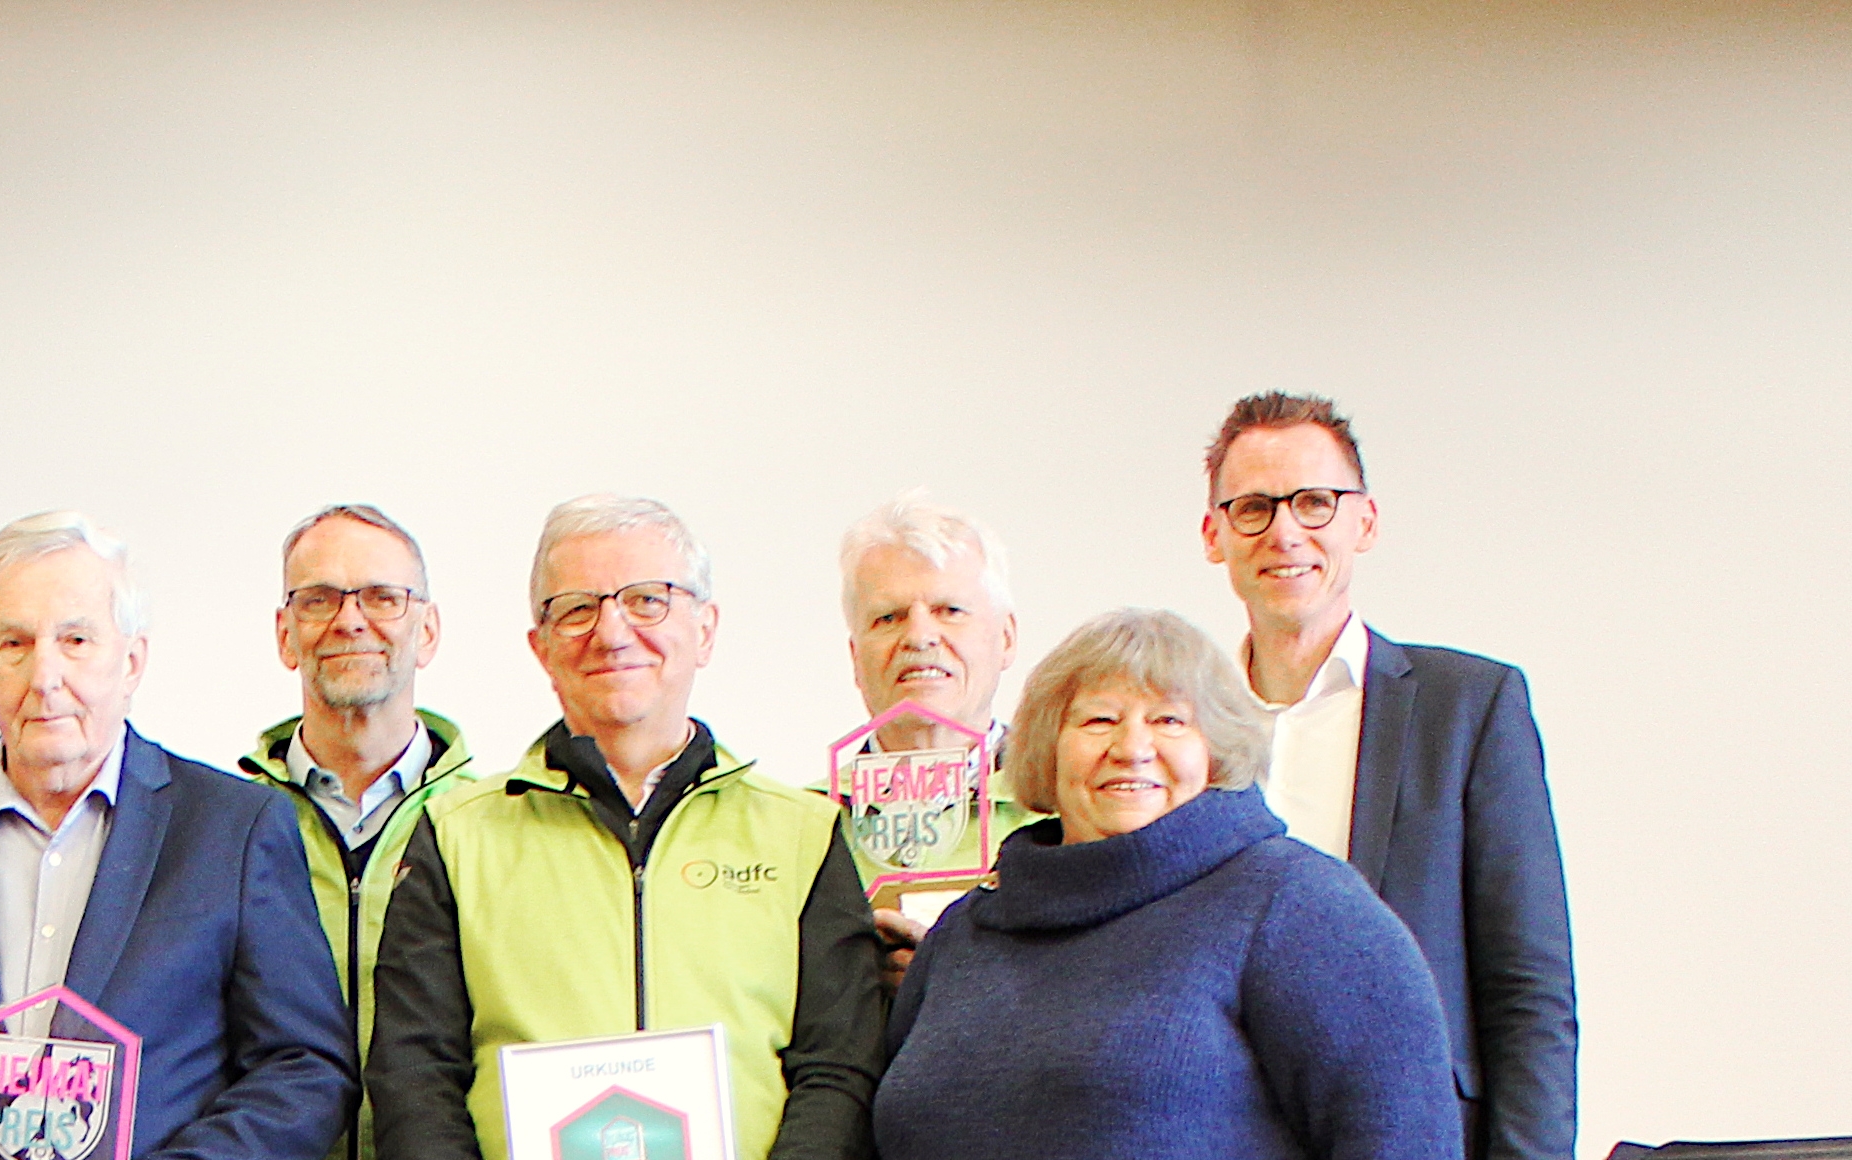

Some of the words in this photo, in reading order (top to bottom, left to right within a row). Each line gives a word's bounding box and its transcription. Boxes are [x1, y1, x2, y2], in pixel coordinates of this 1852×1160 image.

[853, 811, 939, 850] PREIS
[722, 863, 778, 883] adfc
[571, 1058, 656, 1079] URKUNDE
